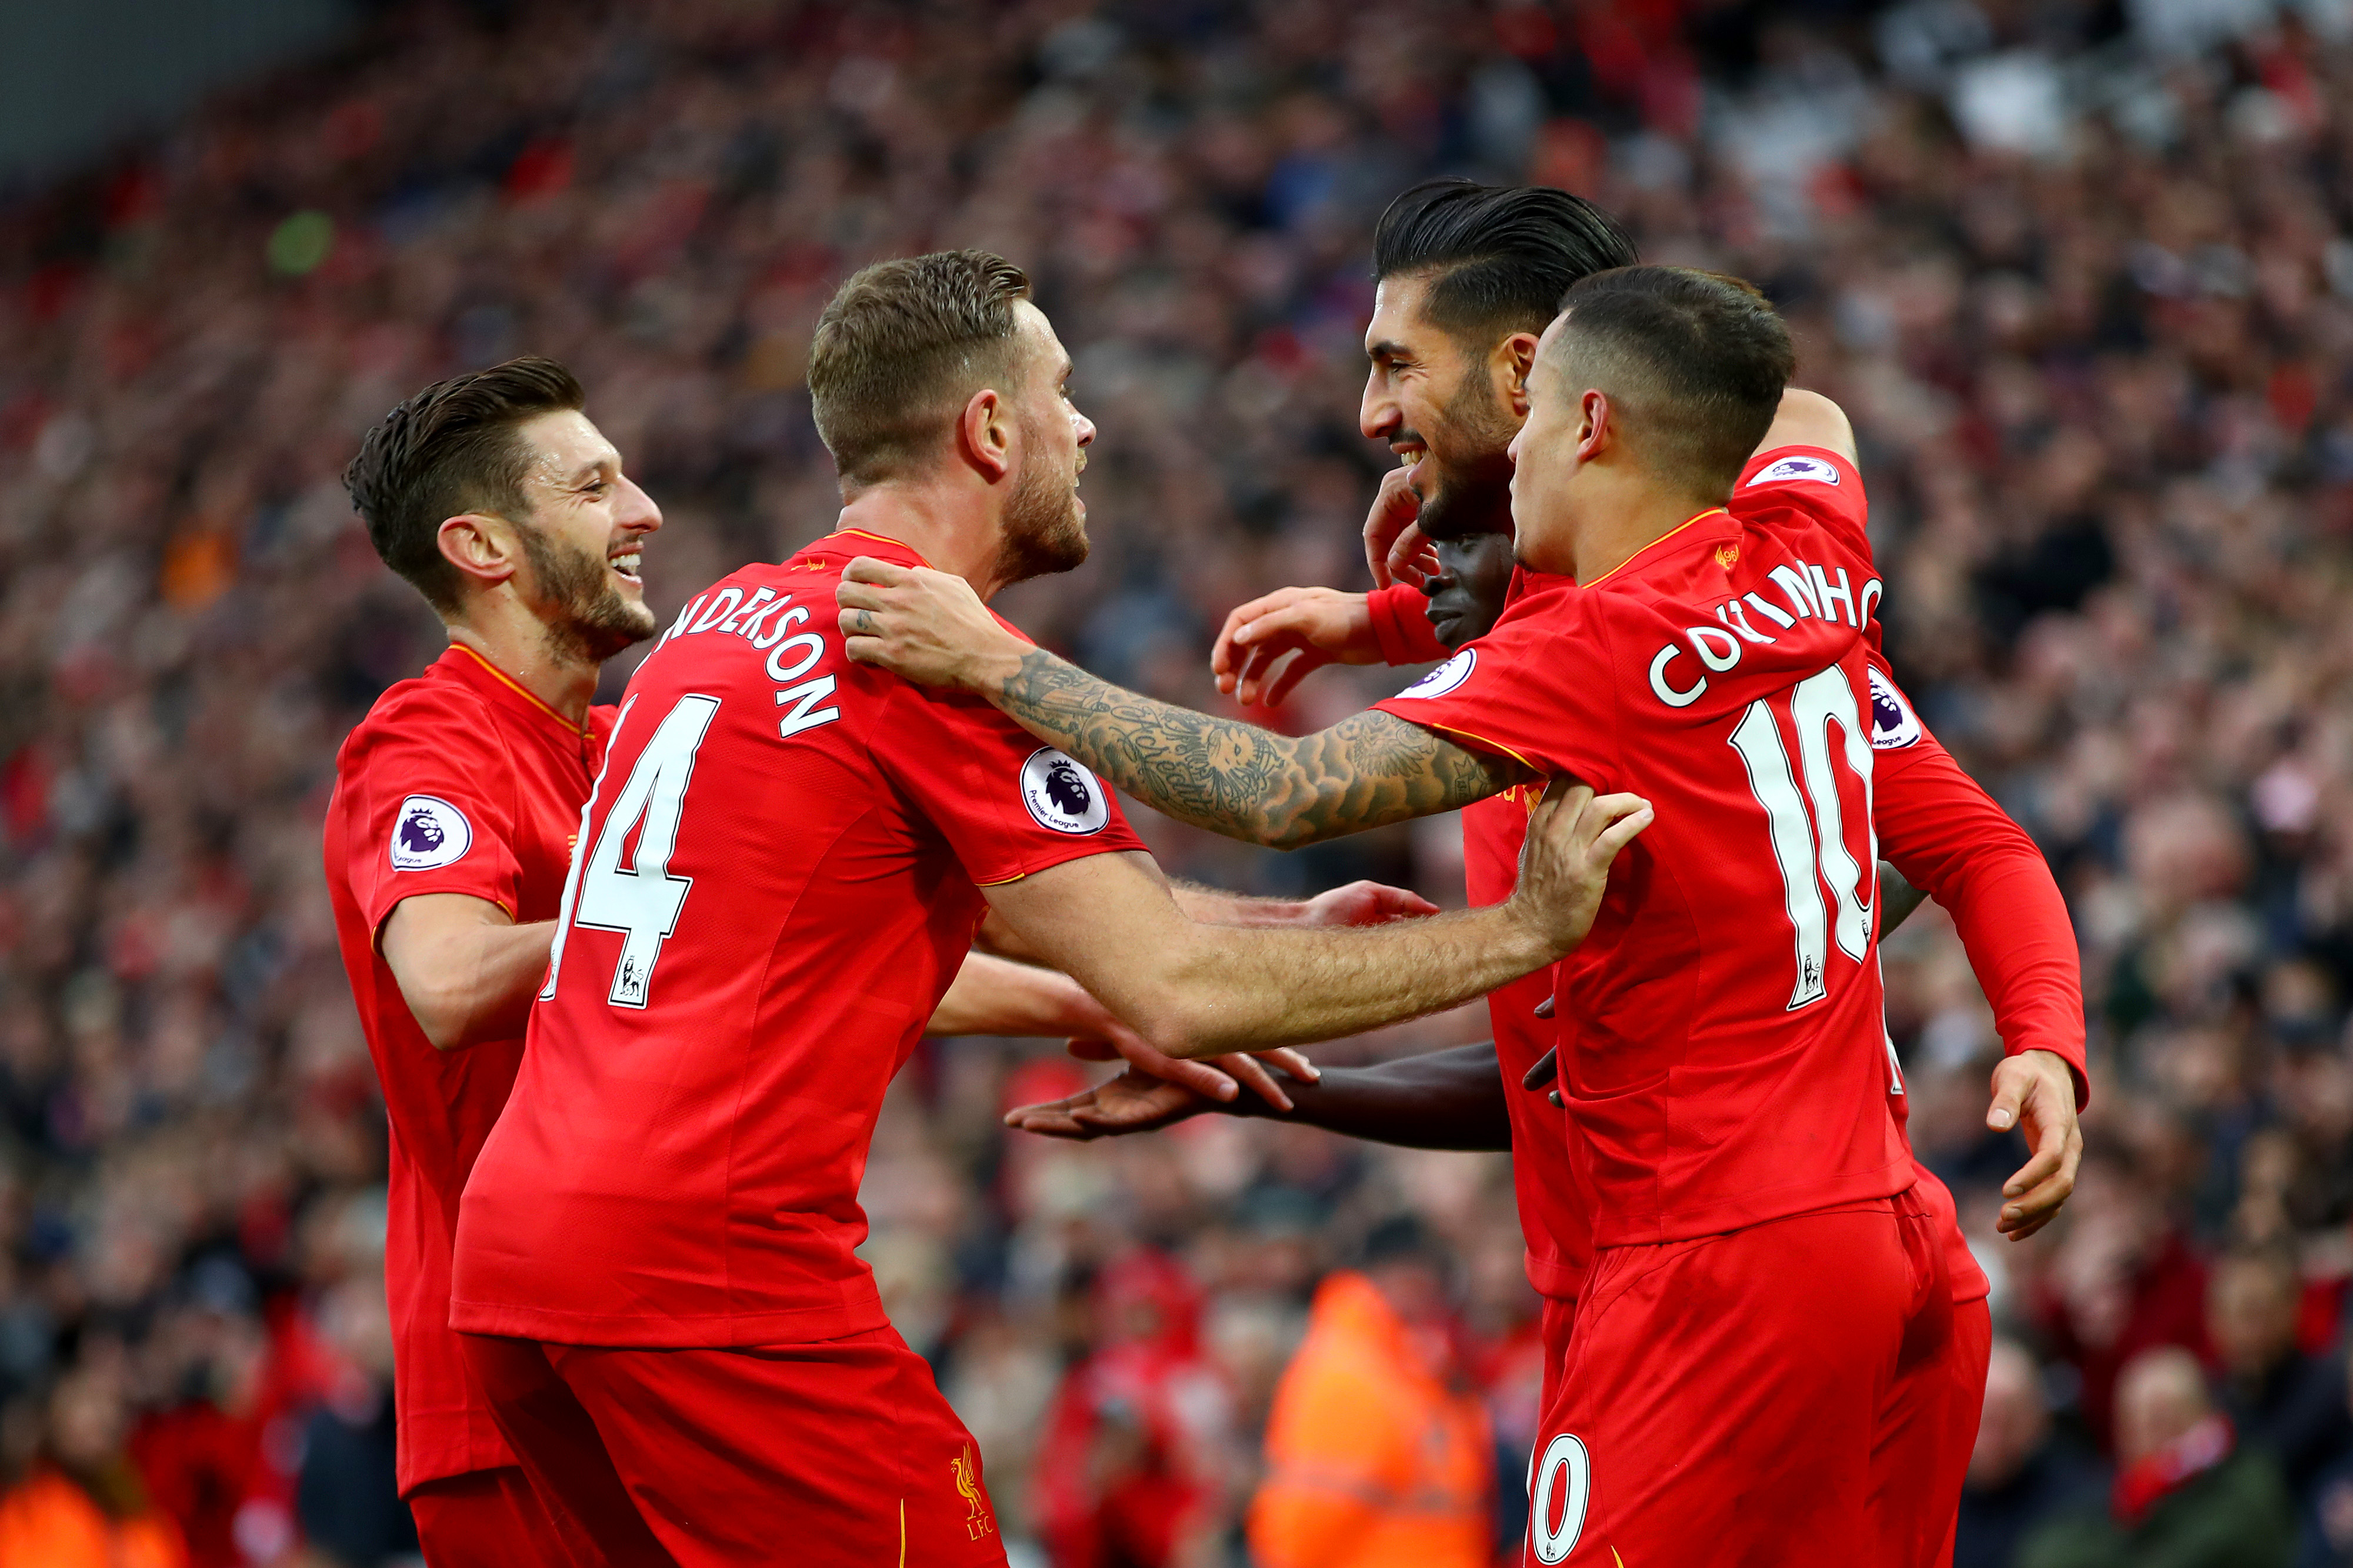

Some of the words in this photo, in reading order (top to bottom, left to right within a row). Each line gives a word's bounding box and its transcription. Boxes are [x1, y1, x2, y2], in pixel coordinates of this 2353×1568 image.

[1723, 550, 1737, 562] 96
[632, 586, 841, 739] NDERSON
[1872, 736, 1902, 746] League
[1029, 789, 1049, 818] Premier
[1049, 814, 1079, 829] League
[1728, 662, 1879, 1010] 10
